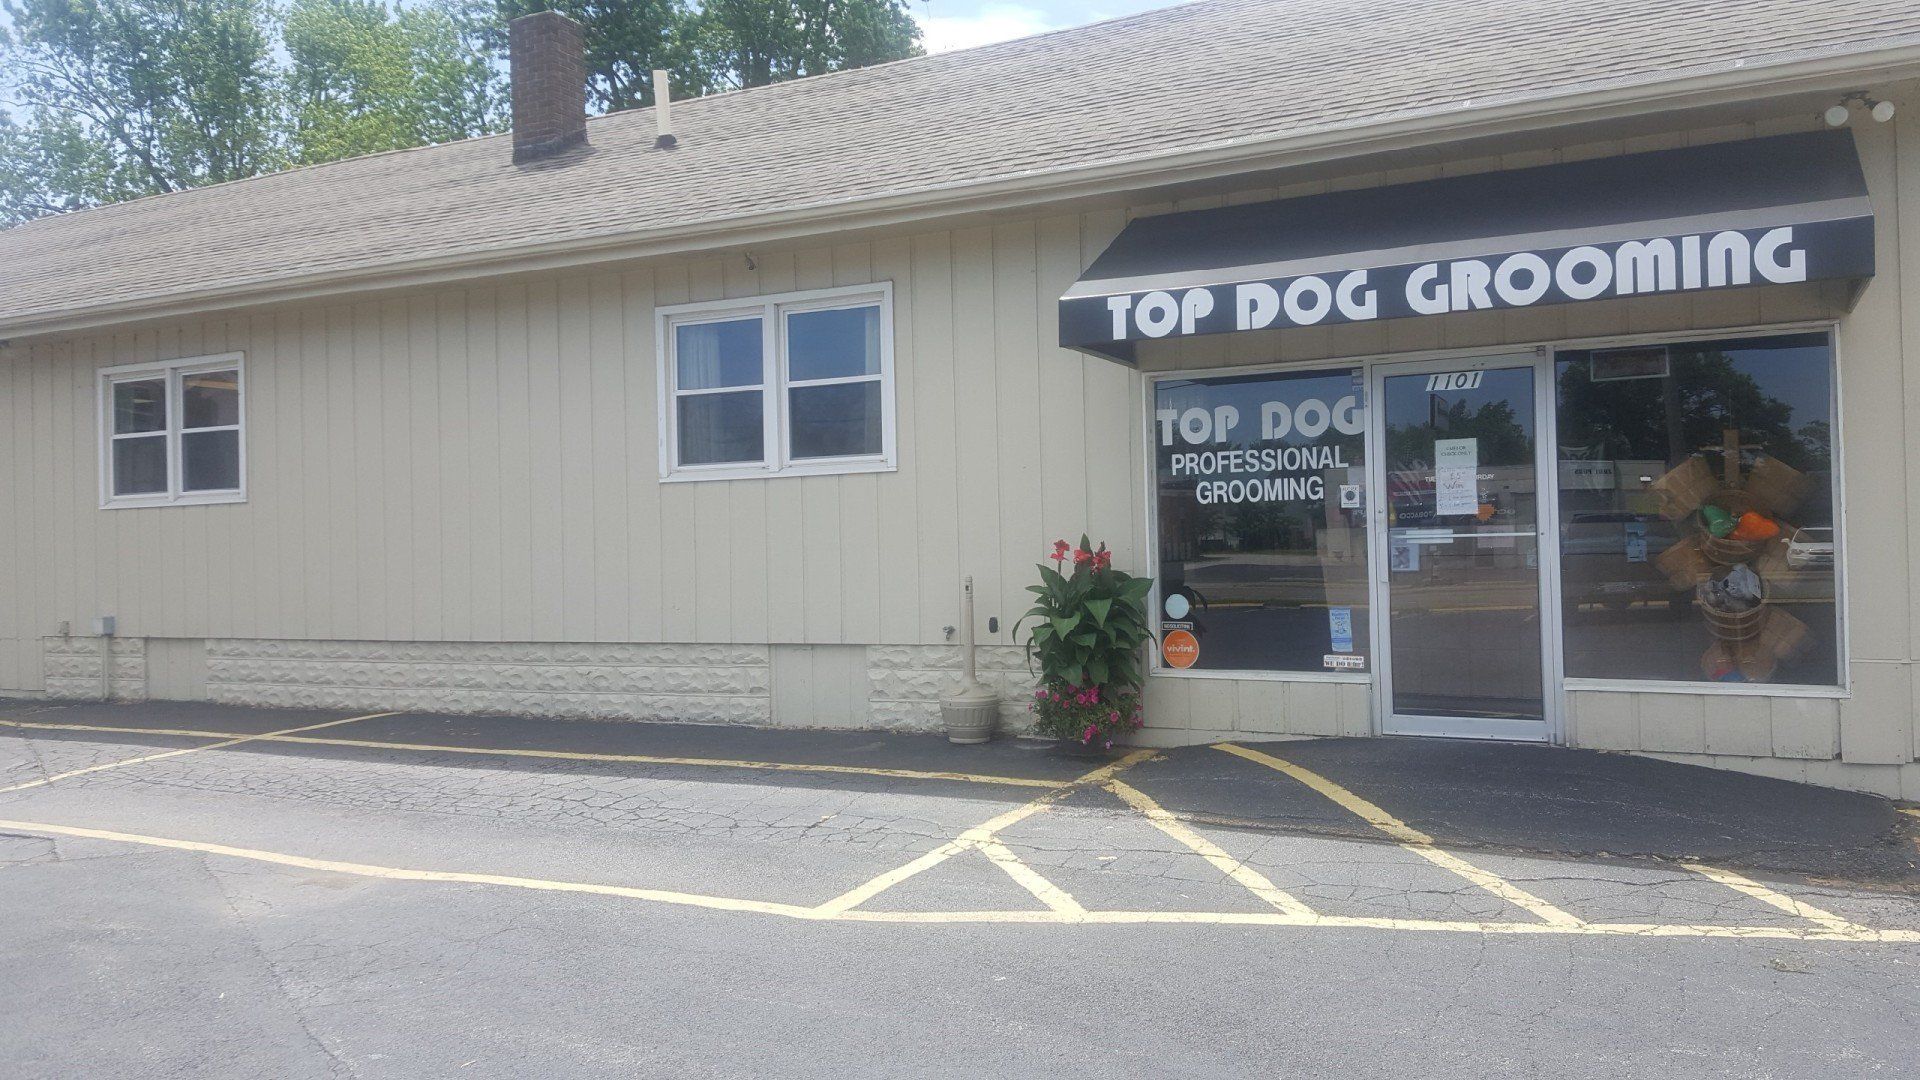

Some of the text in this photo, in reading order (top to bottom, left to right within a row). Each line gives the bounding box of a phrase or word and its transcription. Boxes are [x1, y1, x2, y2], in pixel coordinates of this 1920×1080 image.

[1107, 226, 1806, 340] TOP DOG GROOMING
[1430, 371, 1480, 390] 1101
[1156, 395, 1365, 446] TOP DOG
[1171, 445, 1349, 476] PROFESSIONAL
[1196, 475, 1324, 505] GROOMING
